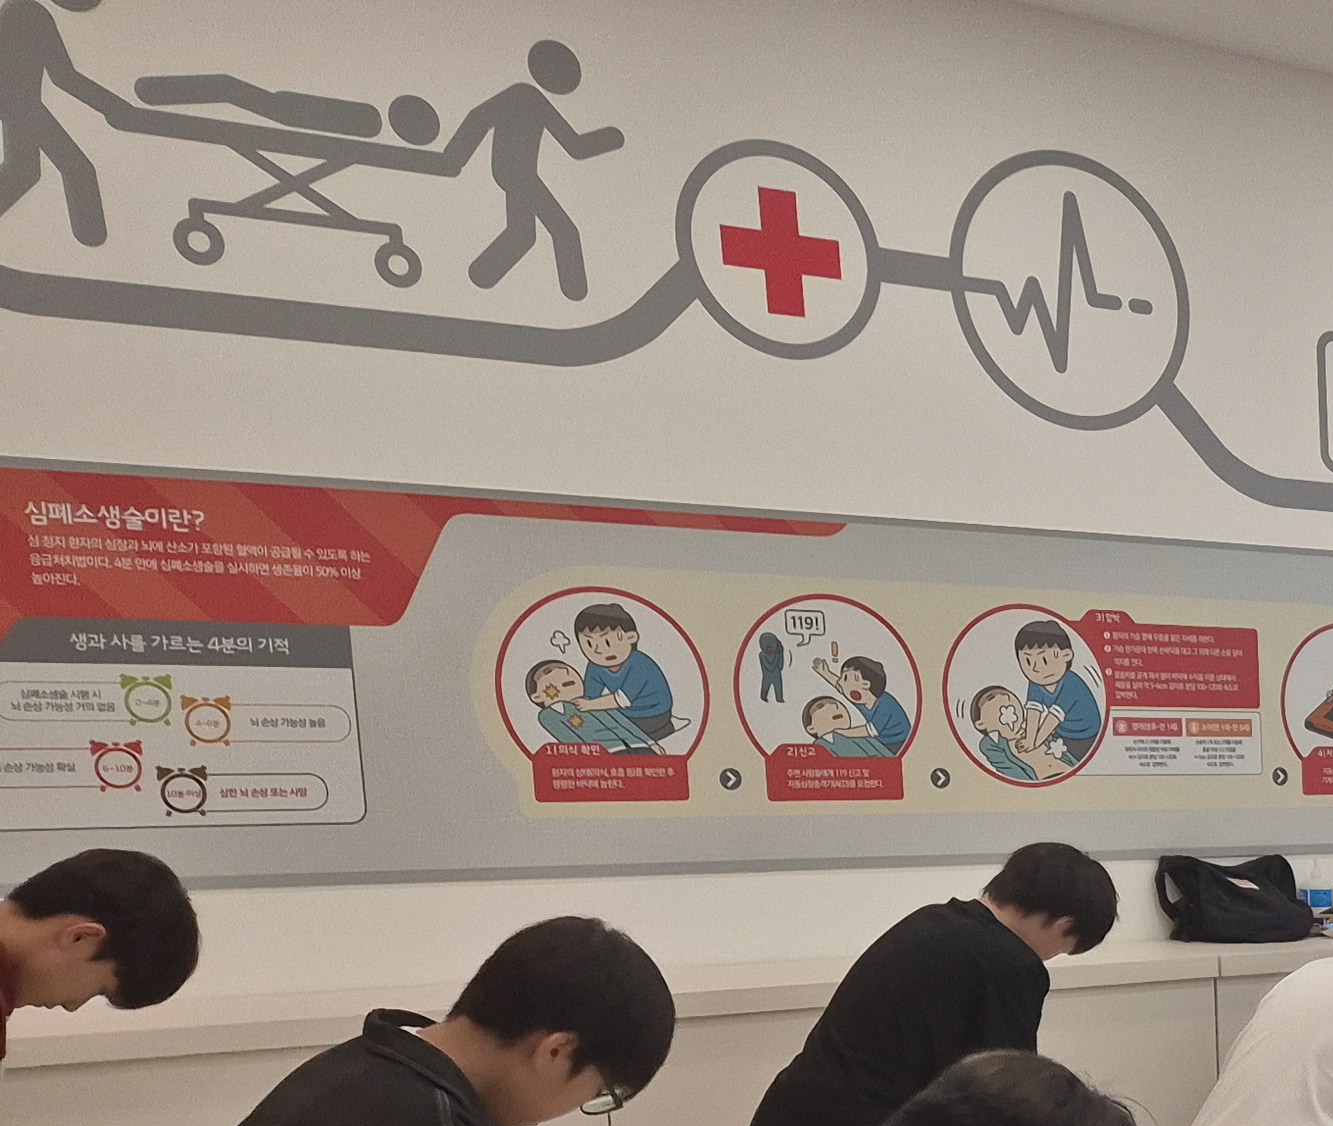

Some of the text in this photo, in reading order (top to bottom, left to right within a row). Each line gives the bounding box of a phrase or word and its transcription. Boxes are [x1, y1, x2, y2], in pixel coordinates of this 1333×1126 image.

[24, 500, 205, 533] 심폐소생술이란?
[43, 535, 65, 549] 정지
[142, 539, 163, 553] 뇌에
[166, 540, 198, 554] 산소가
[304, 547, 315, 560] 수
[350, 549, 371, 563] 하는
[114, 556, 133, 570] 4분
[315, 565, 339, 578] 50%
[340, 566, 361, 580] 이상
[790, 614, 820, 632] 119!
[70, 633, 289, 655] 생과 사를 가르는 4분의 기적
